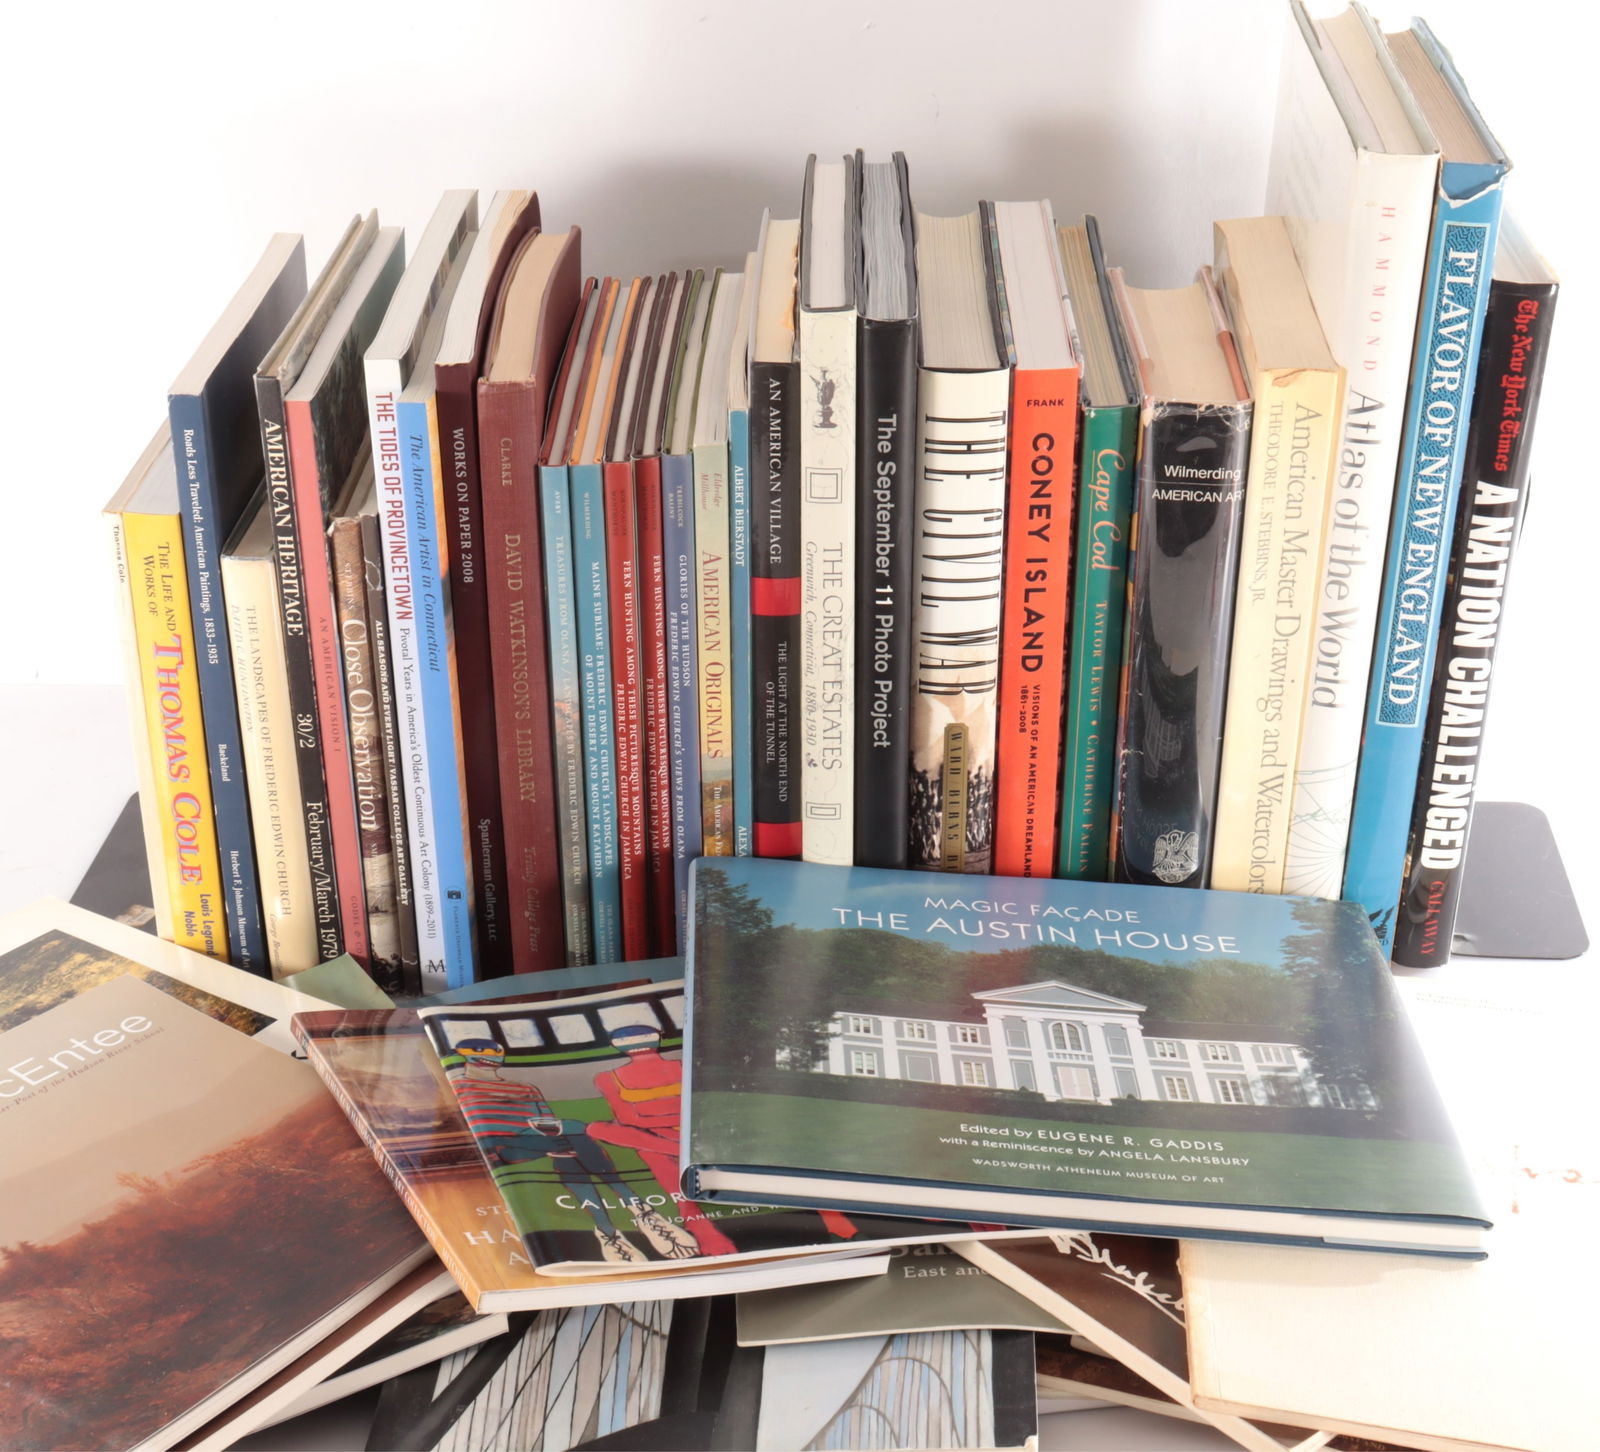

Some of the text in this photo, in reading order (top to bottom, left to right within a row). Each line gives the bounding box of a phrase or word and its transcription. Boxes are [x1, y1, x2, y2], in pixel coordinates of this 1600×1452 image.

[1362, 205, 1395, 372] HAMMOND
[1026, 398, 1064, 408] FRANK
[1491, 298, 1539, 472] The New York Times
[376, 392, 412, 620] THE TIDES OF PROVINCETOWN
[452, 427, 473, 583] WORKS ON PAPER 2008
[500, 437, 513, 486] CLARKE
[734, 464, 744, 566] ALBERT BIERSTADT
[769, 378, 781, 563] AN AMERICAN VILLAGE
[1087, 448, 1127, 570] Cape Cod
[1164, 465, 1240, 480] Wilmerding
[1245, 399, 1285, 606] THEODORE E. STEBBINS, JR.
[1284, 401, 1323, 522] American
[1387, 245, 1477, 706] FLAVOR OF NEW ENGLAND
[143, 554, 159, 617] WORKS OF
[157, 541, 176, 631] THE LIFE AND
[183, 428, 218, 664] Roads Less Traveled: American Paintings, 1833-1935
[264, 417, 303, 636] AMERICAN HERITAGE
[409, 434, 441, 672] The American Artist in Connecticut
[870, 413, 896, 747] The September 11 Photo Project
[918, 408, 1005, 696] THE CIVIL WAR
[1020, 432, 1054, 672] CONEY ISLAND
[1275, 526, 1310, 608] Master
[1310, 385, 1388, 710] Atlas of the World
[504, 533, 535, 803] DAVID WATKINSON'S LIBRARY
[679, 554, 690, 686] GLORIES OF THE HUDSON
[702, 549, 725, 758] AMERICAN ORIGINALS
[820, 542, 843, 770] THE GREAT ESTATES
[1257, 610, 1301, 724] Drawings
[1418, 480, 1518, 873] A NATION CHALLENGED
[152, 632, 207, 886] THOMAS COLE
[296, 712, 315, 748] 30/2
[341, 617, 382, 829] Close Observation
[623, 560, 642, 855] FERN HUNTING AMONG THESE PICTURESQUE MOUNTAINS
[765, 681, 774, 763] OF THE TUNNEL
[778, 640, 786, 801] THE LIGHT AT THE NORTH END
[1019, 685, 1027, 733] 1861-2008
[1077, 599, 1107, 872] TAYLOR LEWIS CATHERINE FALLIN
[1258, 727, 1289, 770] and
[1023, 684, 1040, 877] VISIONS OF AN AMERICAN DREAMLAND
[181, 909, 199, 937] Noble
[198, 892, 219, 957] Louis Legrand
[304, 800, 339, 958] February/March 1979
[478, 817, 497, 940] Spanierman Gallery, LLC
[832, 908, 1240, 953] THE AUSTIN HOUSE
[924, 897, 1140, 923] MAGIC FAÇADE
[1418, 879, 1445, 956] CALLAWAY
[556, 1192, 685, 1210] CALIFOR
[939, 1137, 967, 1145] with
[982, 1140, 1073, 1155] Reminiscence
[1078, 1148, 1094, 1157] by
[1099, 1150, 1164, 1161] ANGELA
[1170, 1154, 1249, 1166] LANSBURY
[960, 1124, 1224, 1151] Edited by EUGENE R. GADDIS
[972, 1158, 1050, 1171] WADSWORTH
[1056, 1166, 1121, 1177] ATHENEUM
[1126, 1172, 1177, 1181] MUSEUM
[1203, 1176, 1224, 1184] ART
[667, 1211, 723, 1224] JOANNE
[732, 1206, 759, 1215] AND
[903, 1266, 946, 1278] East
